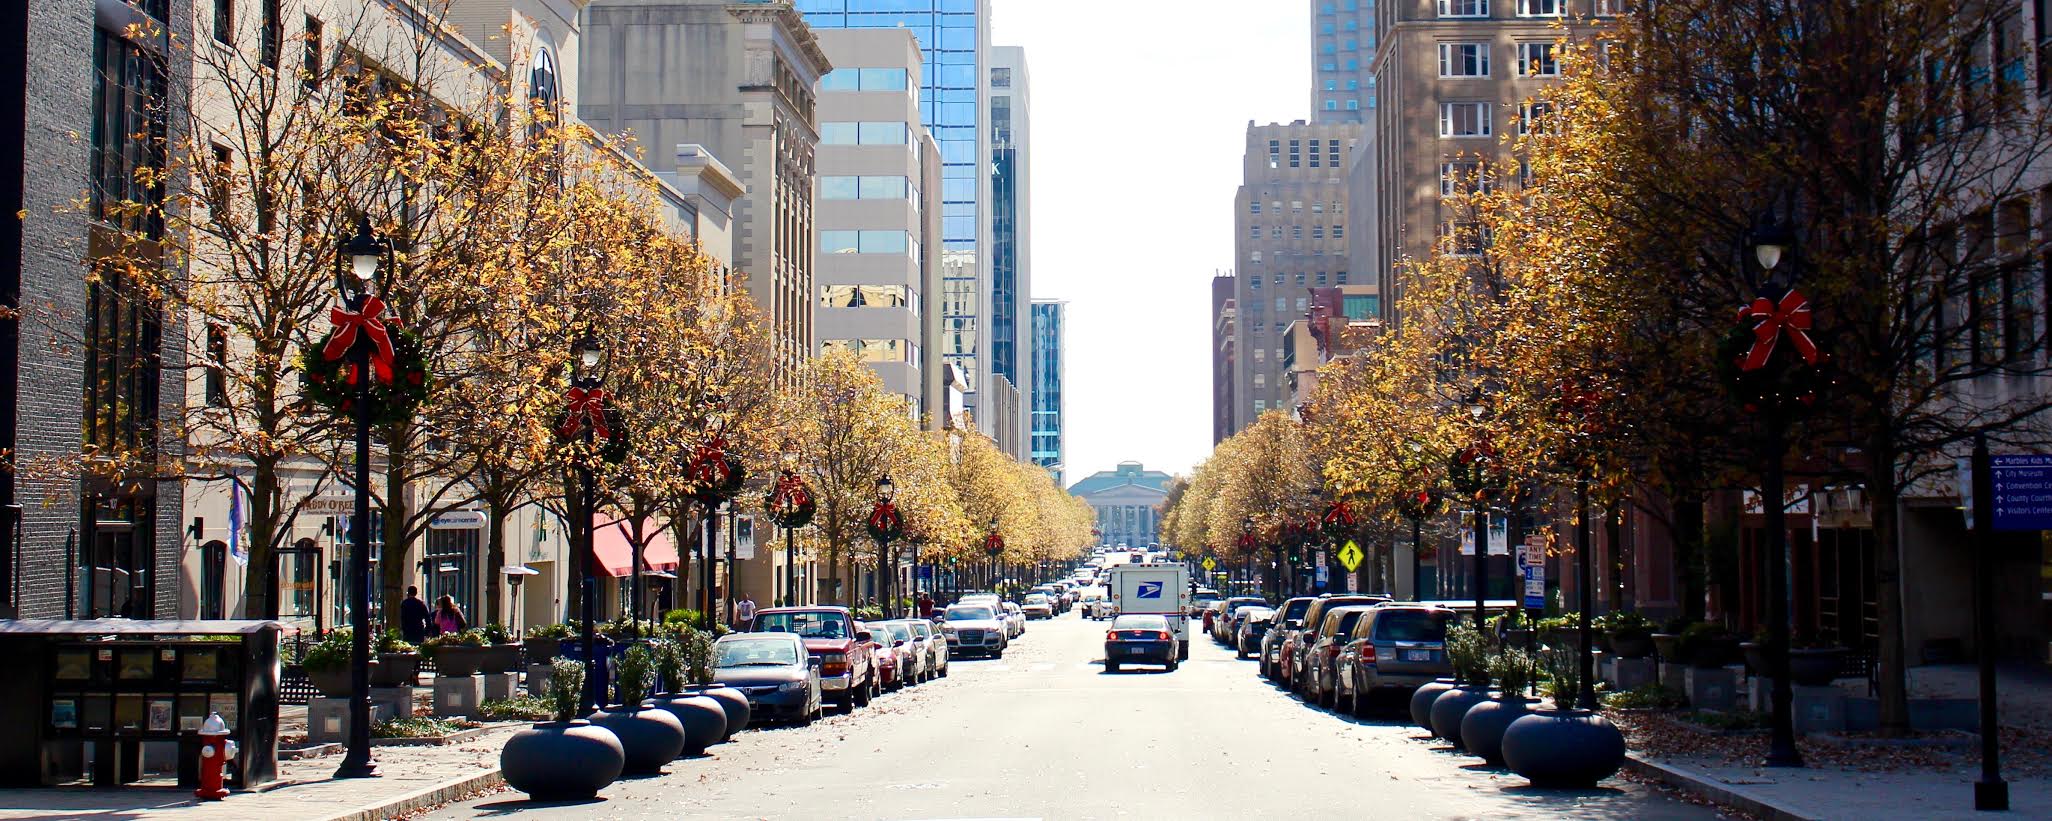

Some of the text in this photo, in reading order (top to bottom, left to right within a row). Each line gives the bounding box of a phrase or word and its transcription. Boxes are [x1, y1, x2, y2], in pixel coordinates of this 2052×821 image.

[991, 162, 1001, 175] K
[2005, 457, 2029, 465] Marbles
[2031, 457, 2044, 465] Kids
[2005, 470, 2016, 478] City
[2006, 482, 2043, 490] Convention
[2006, 494, 2029, 504] County
[2007, 506, 2031, 515] Visitors
